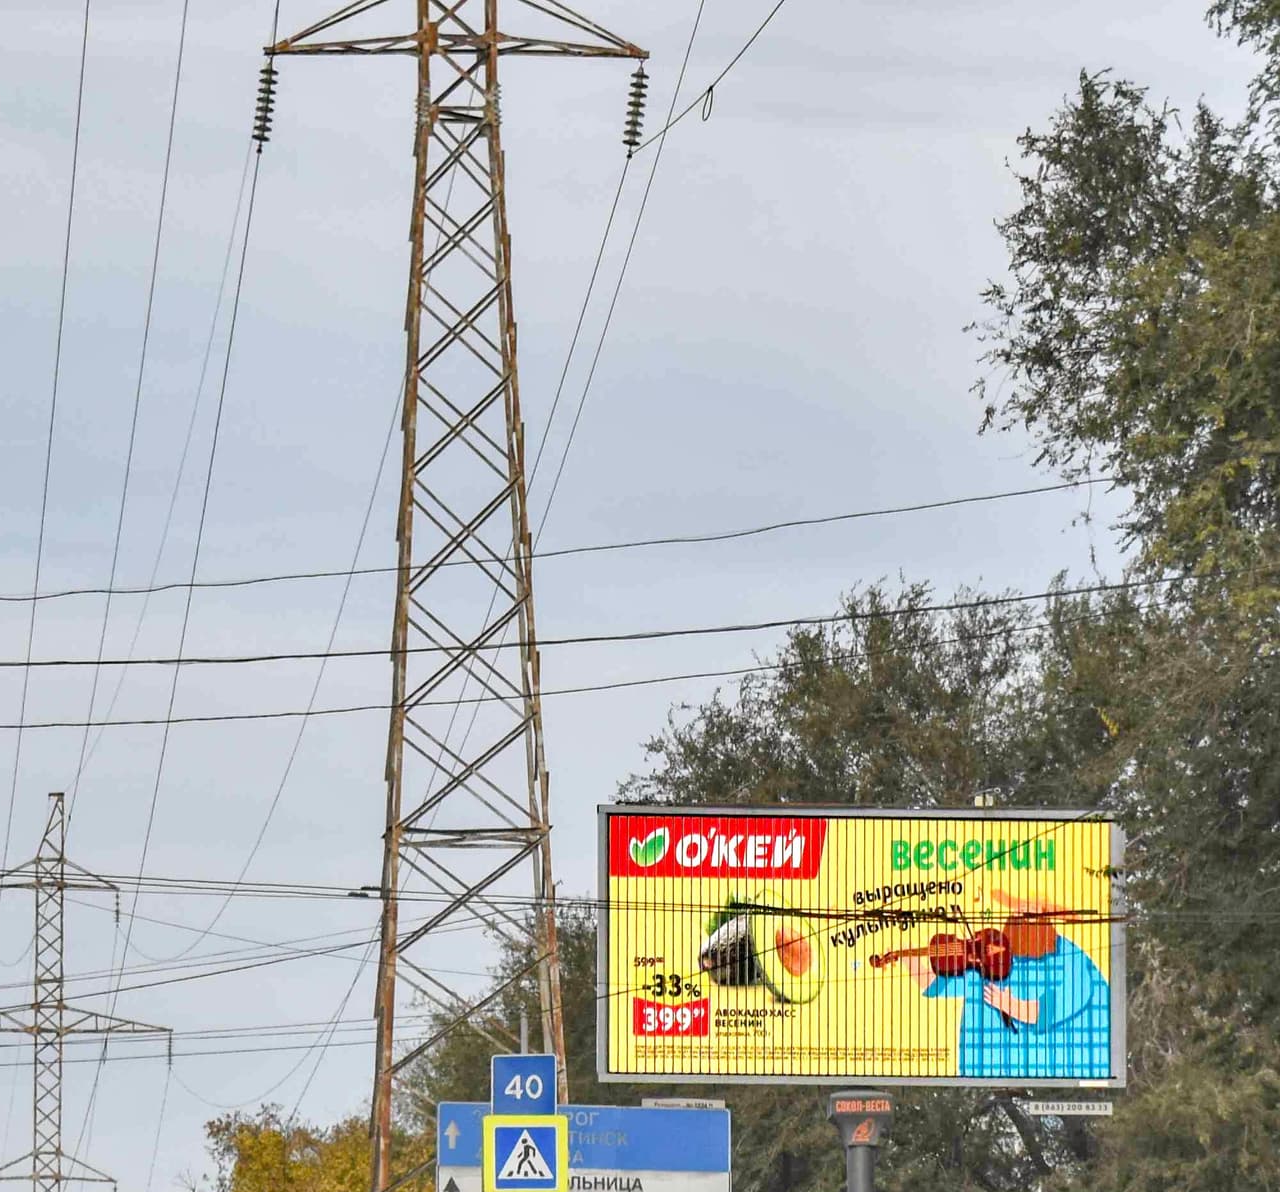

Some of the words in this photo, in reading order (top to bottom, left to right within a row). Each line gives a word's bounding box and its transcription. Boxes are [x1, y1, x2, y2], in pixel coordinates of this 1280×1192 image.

[715, 1008, 768, 1018] АВОКАДО
[715, 1019, 763, 1028] ВЕСЕНИН
[504, 1075, 543, 1100] 40
